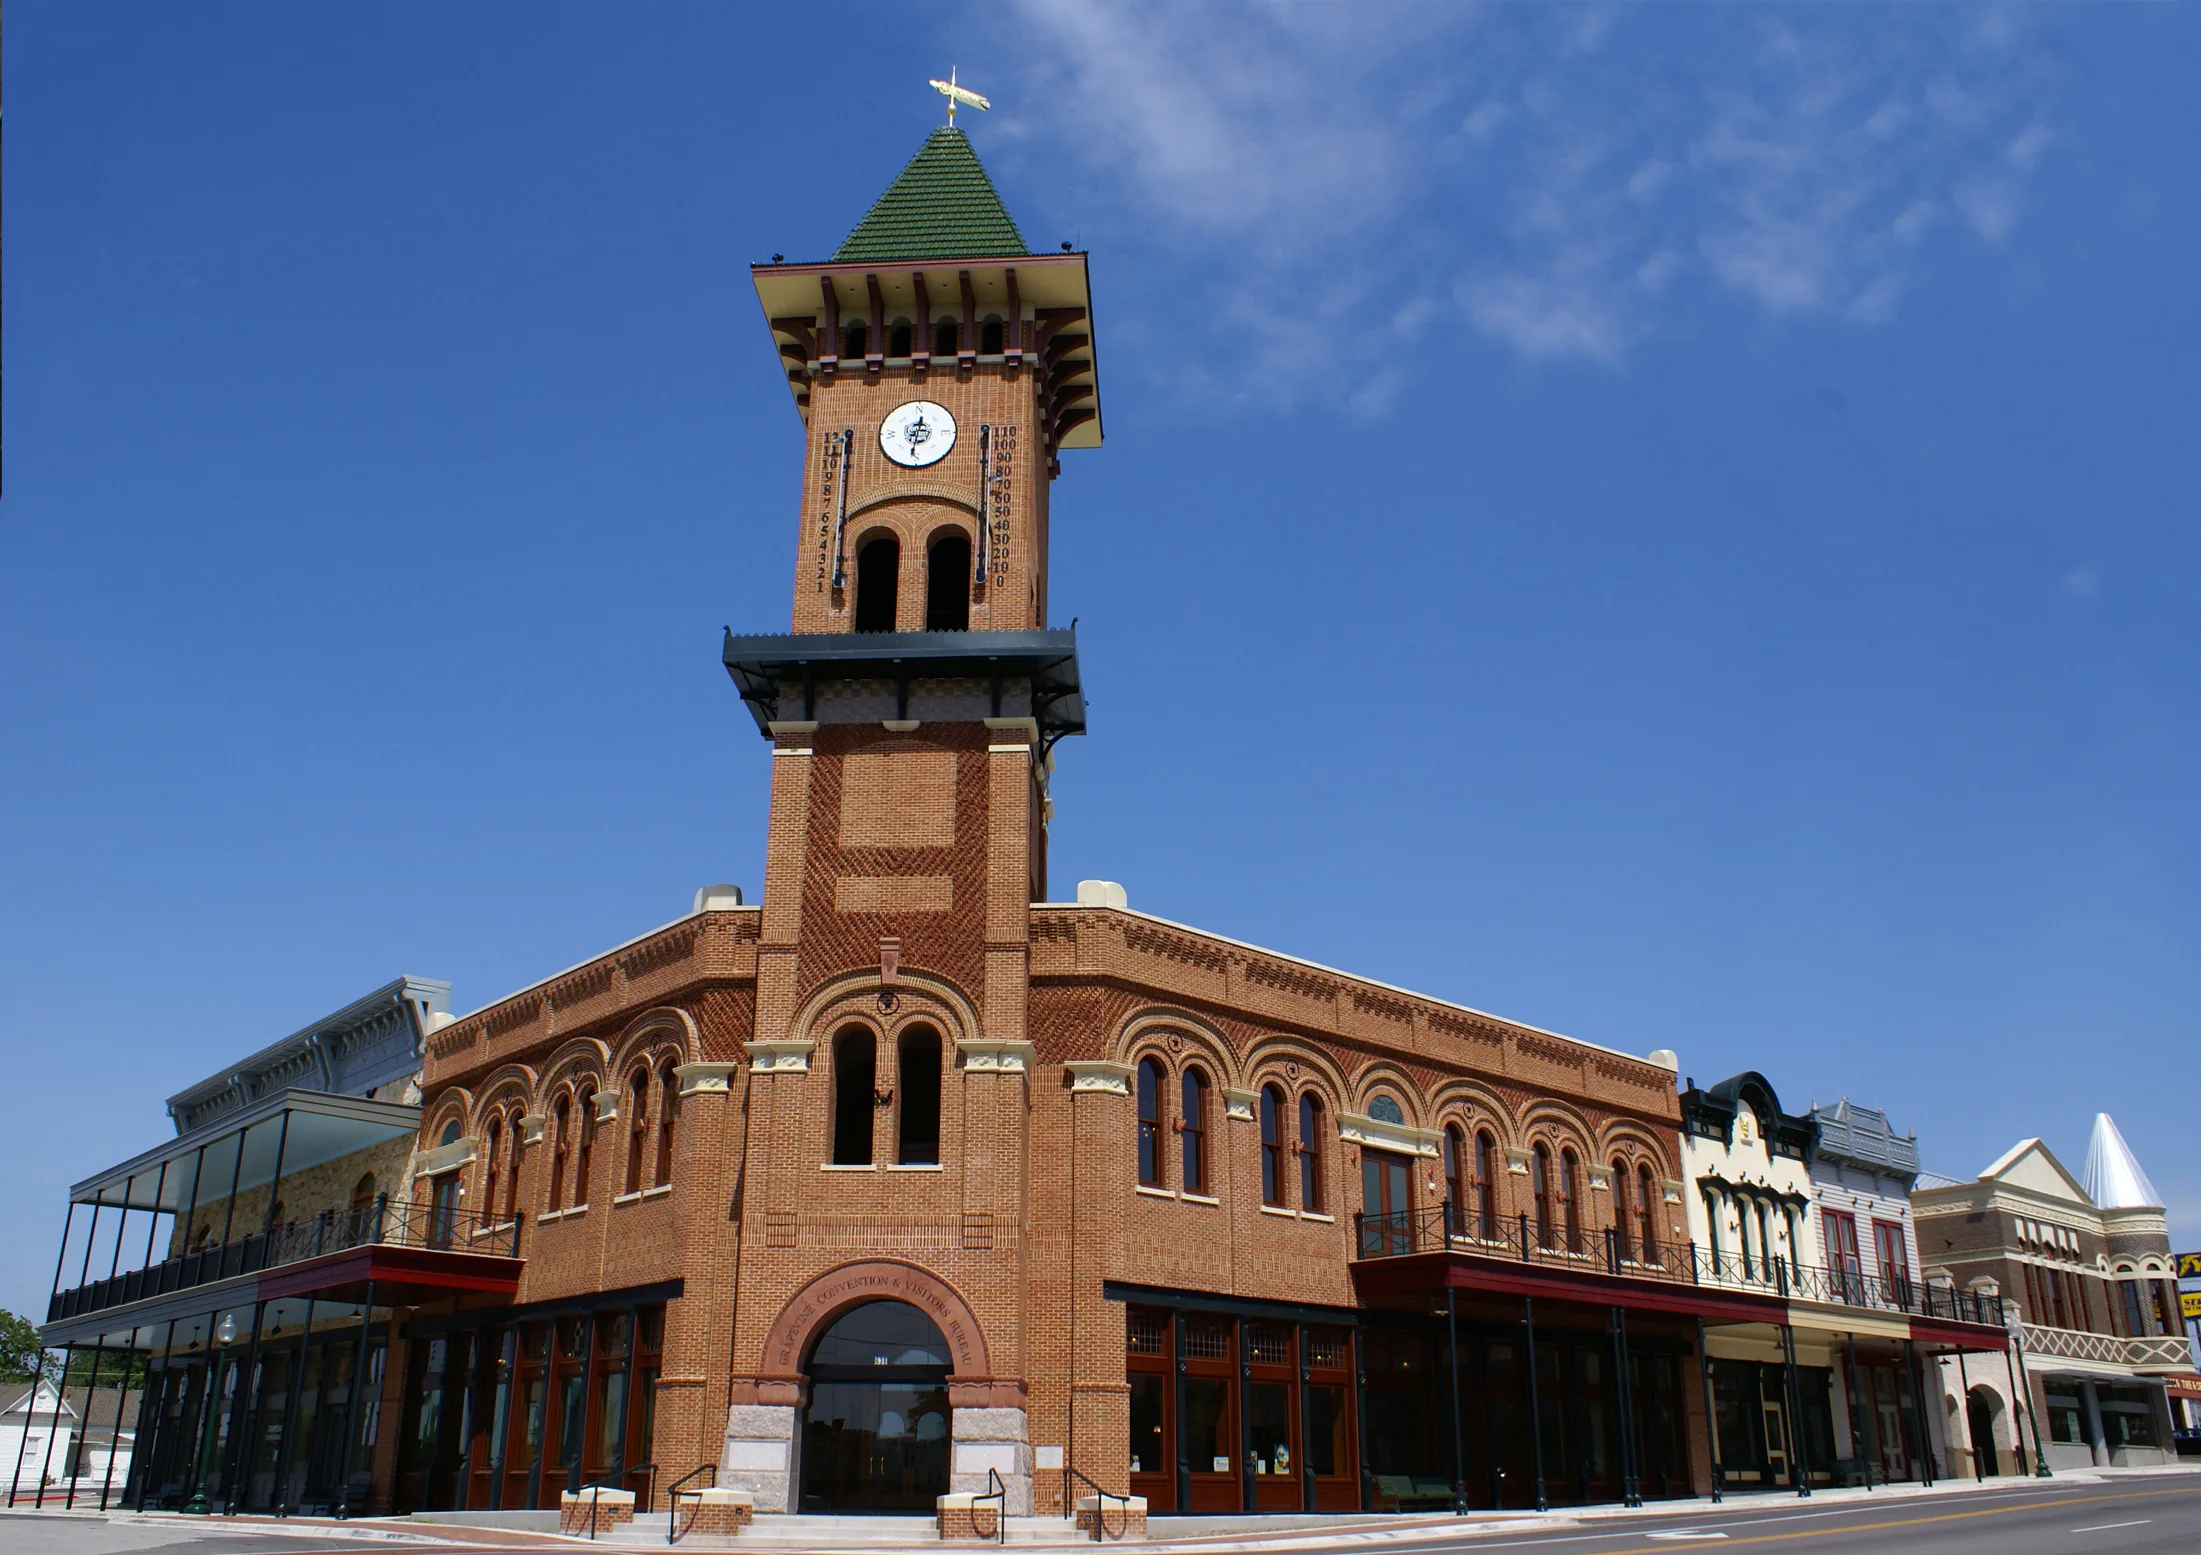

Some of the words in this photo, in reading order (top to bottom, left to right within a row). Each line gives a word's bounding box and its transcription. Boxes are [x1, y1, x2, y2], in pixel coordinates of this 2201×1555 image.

[915, 405, 923, 414] N
[886, 429, 896, 440] W
[994, 426, 1016, 437] 110
[824, 432, 838, 443] 12
[994, 439, 1016, 450] 100
[823, 445, 837, 456] 11
[913, 452, 920, 462] S
[997, 452, 1012, 464] 90
[822, 459, 837, 469] 10
[996, 465, 1011, 477] 80
[824, 471, 832, 483] 9
[823, 484, 831, 496] 8
[823, 497, 831, 509] 7
[994, 492, 1011, 504] 60
[821, 512, 830, 523] 6
[994, 506, 1010, 518] 50
[820, 525, 828, 536] 5
[994, 520, 1010, 531] 40
[993, 533, 1009, 545] 30
[819, 540, 827, 550] 4
[818, 553, 825, 564] 3
[993, 547, 1009, 559] 20
[993, 561, 1008, 573] 10
[817, 567, 824, 579] 2
[996, 575, 1004, 587] 0
[816, 582, 823, 593] 1
[779, 1304, 816, 1366] GRAPEVINE
[817, 1276, 889, 1305] CONVENTION
[893, 1279, 901, 1288] &
[905, 1280, 951, 1318] VISITORS
[949, 1319, 972, 1366] BUREAU
